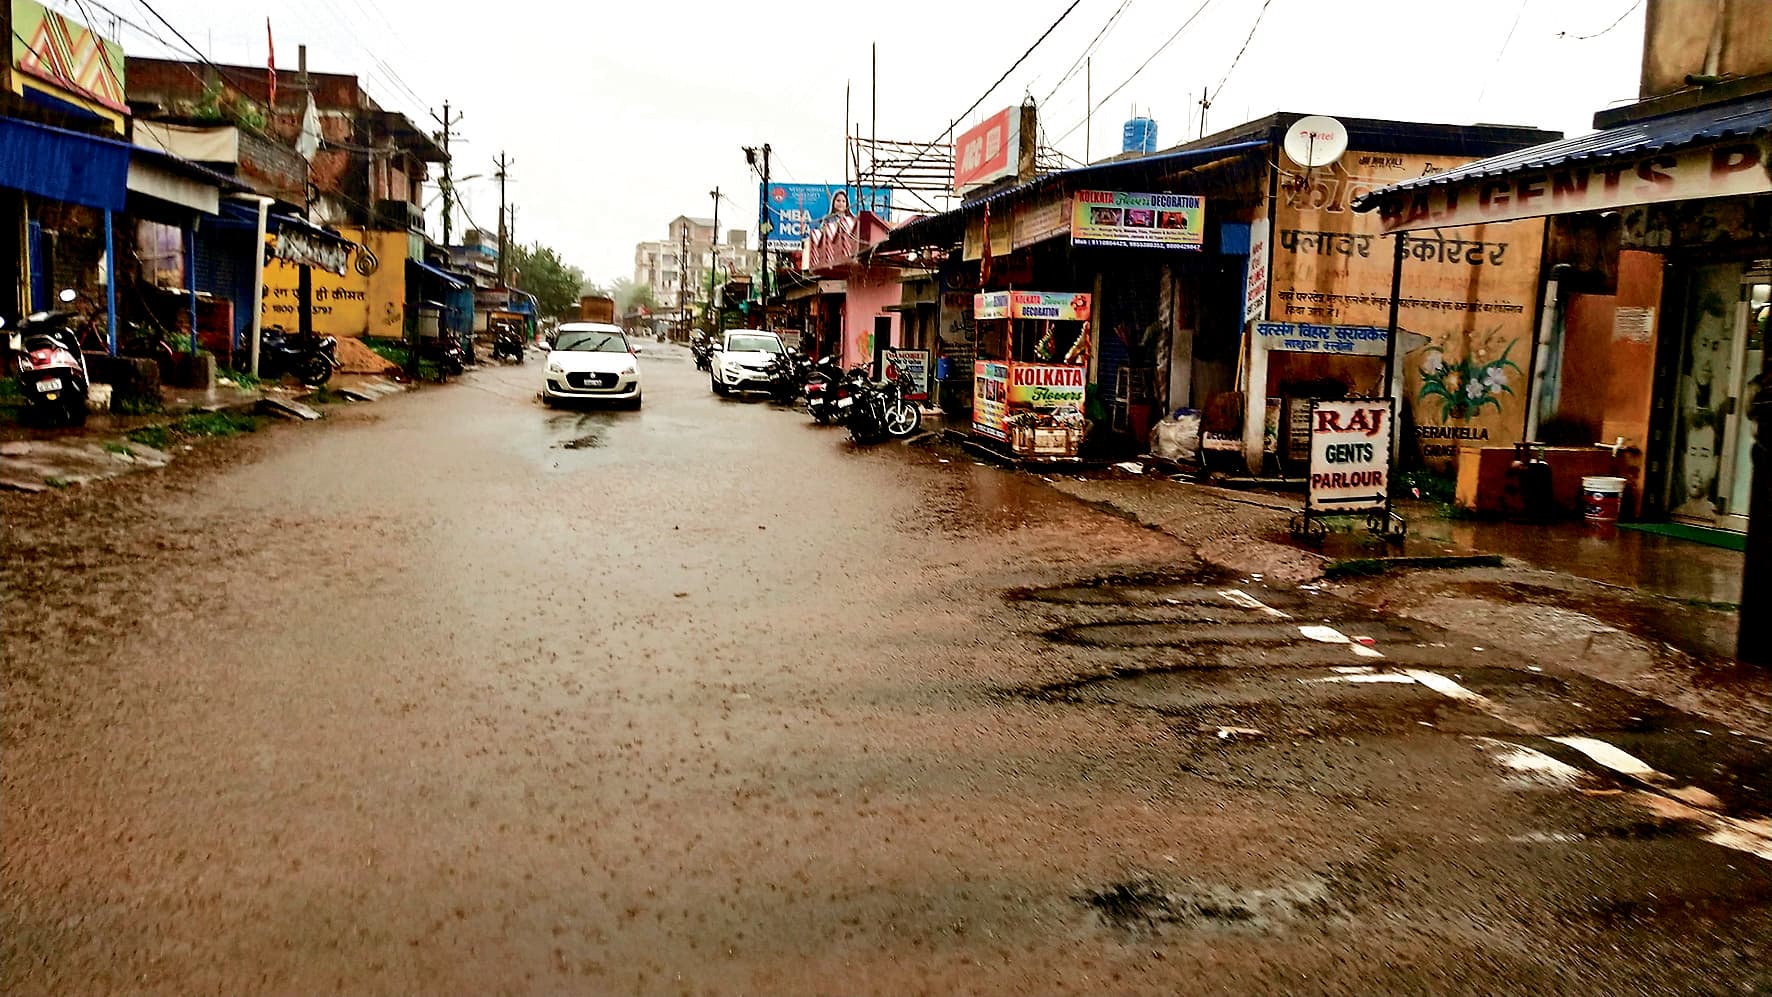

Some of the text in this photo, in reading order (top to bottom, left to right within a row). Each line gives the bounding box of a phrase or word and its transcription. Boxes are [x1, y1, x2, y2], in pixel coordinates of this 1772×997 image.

[1478, 155, 1677, 217] GENTS
[1080, 191, 1114, 204] KOLKATA
[1151, 195, 1200, 208] DECORATION
[780, 209, 811, 221] MBA
[1016, 295, 1041, 304] KOLKATA
[1022, 306, 1059, 317] DECORATION
[1257, 322, 1389, 341] सत्संग विहार सरायकेल
[1014, 368, 1083, 386] KOLKATA
[1032, 386, 1083, 401] Flowers
[1314, 408, 1385, 437] RAJ
[1415, 425, 1489, 440] SERAIKELLA
[1325, 443, 1373, 463] GENTS
[1312, 471, 1382, 489] PARLOUR
